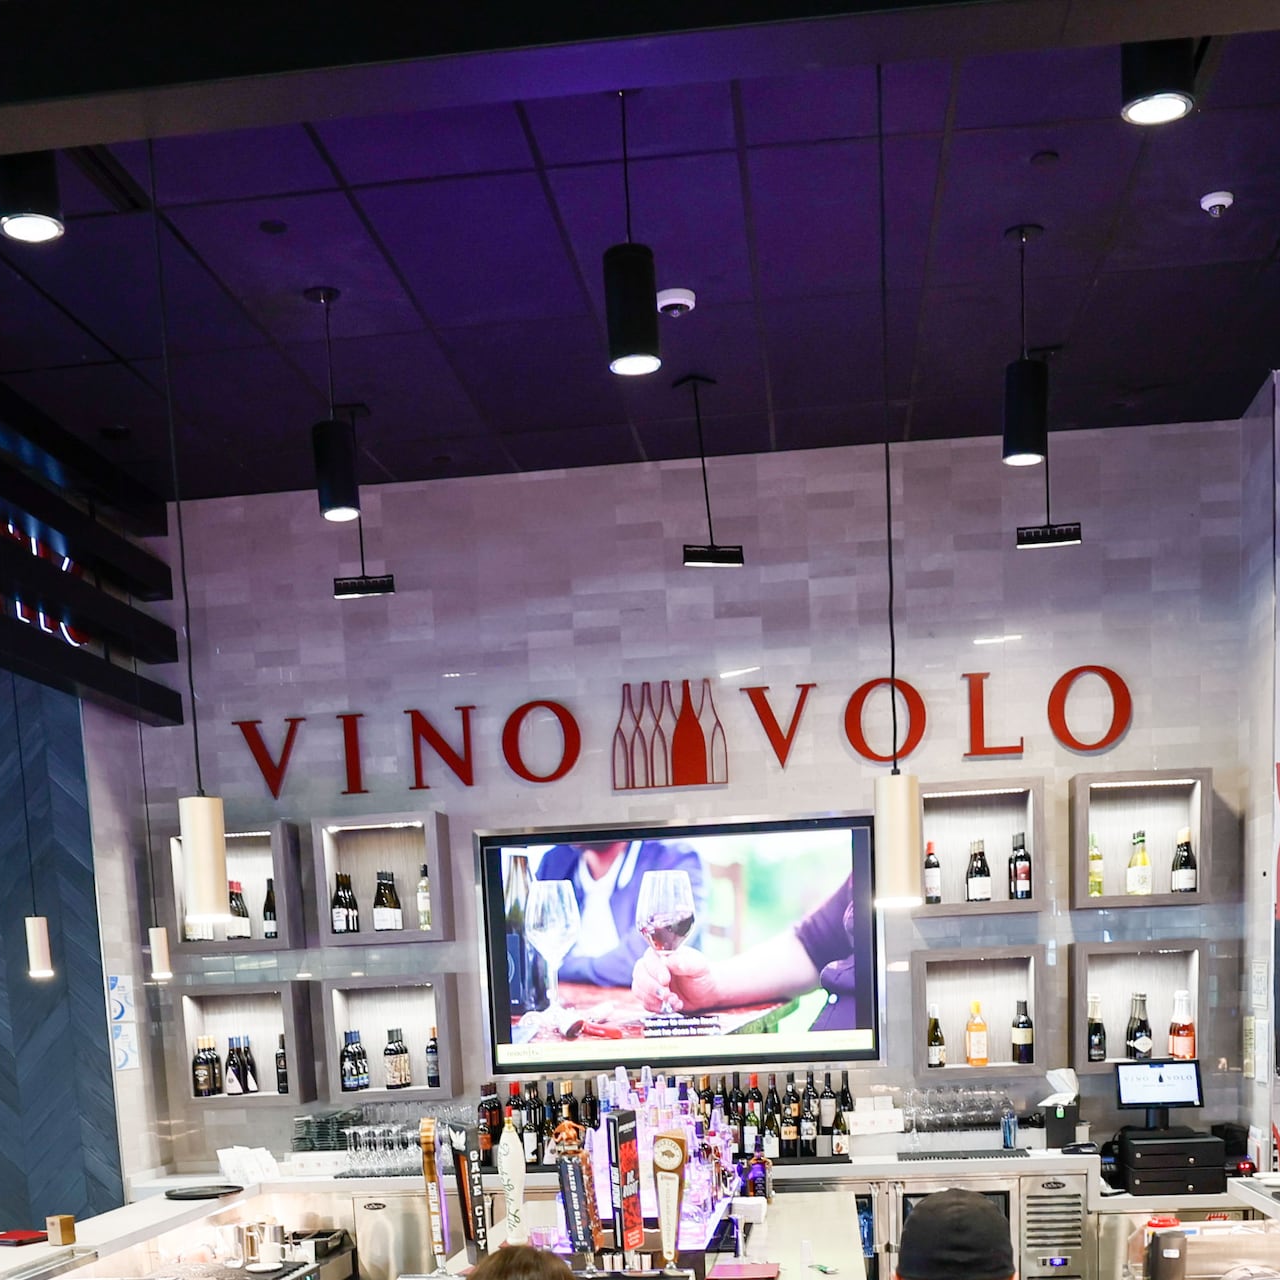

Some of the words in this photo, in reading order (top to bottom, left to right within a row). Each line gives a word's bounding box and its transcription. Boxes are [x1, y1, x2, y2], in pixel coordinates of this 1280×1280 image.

[231, 698, 583, 799] VINO
[737, 664, 1132, 769] VOLO
[469, 1150, 483, 1197] GATE
[566, 1163, 577, 1192] HAZED
[571, 1191, 580, 1210] AND
[474, 1205, 487, 1251] CITY
